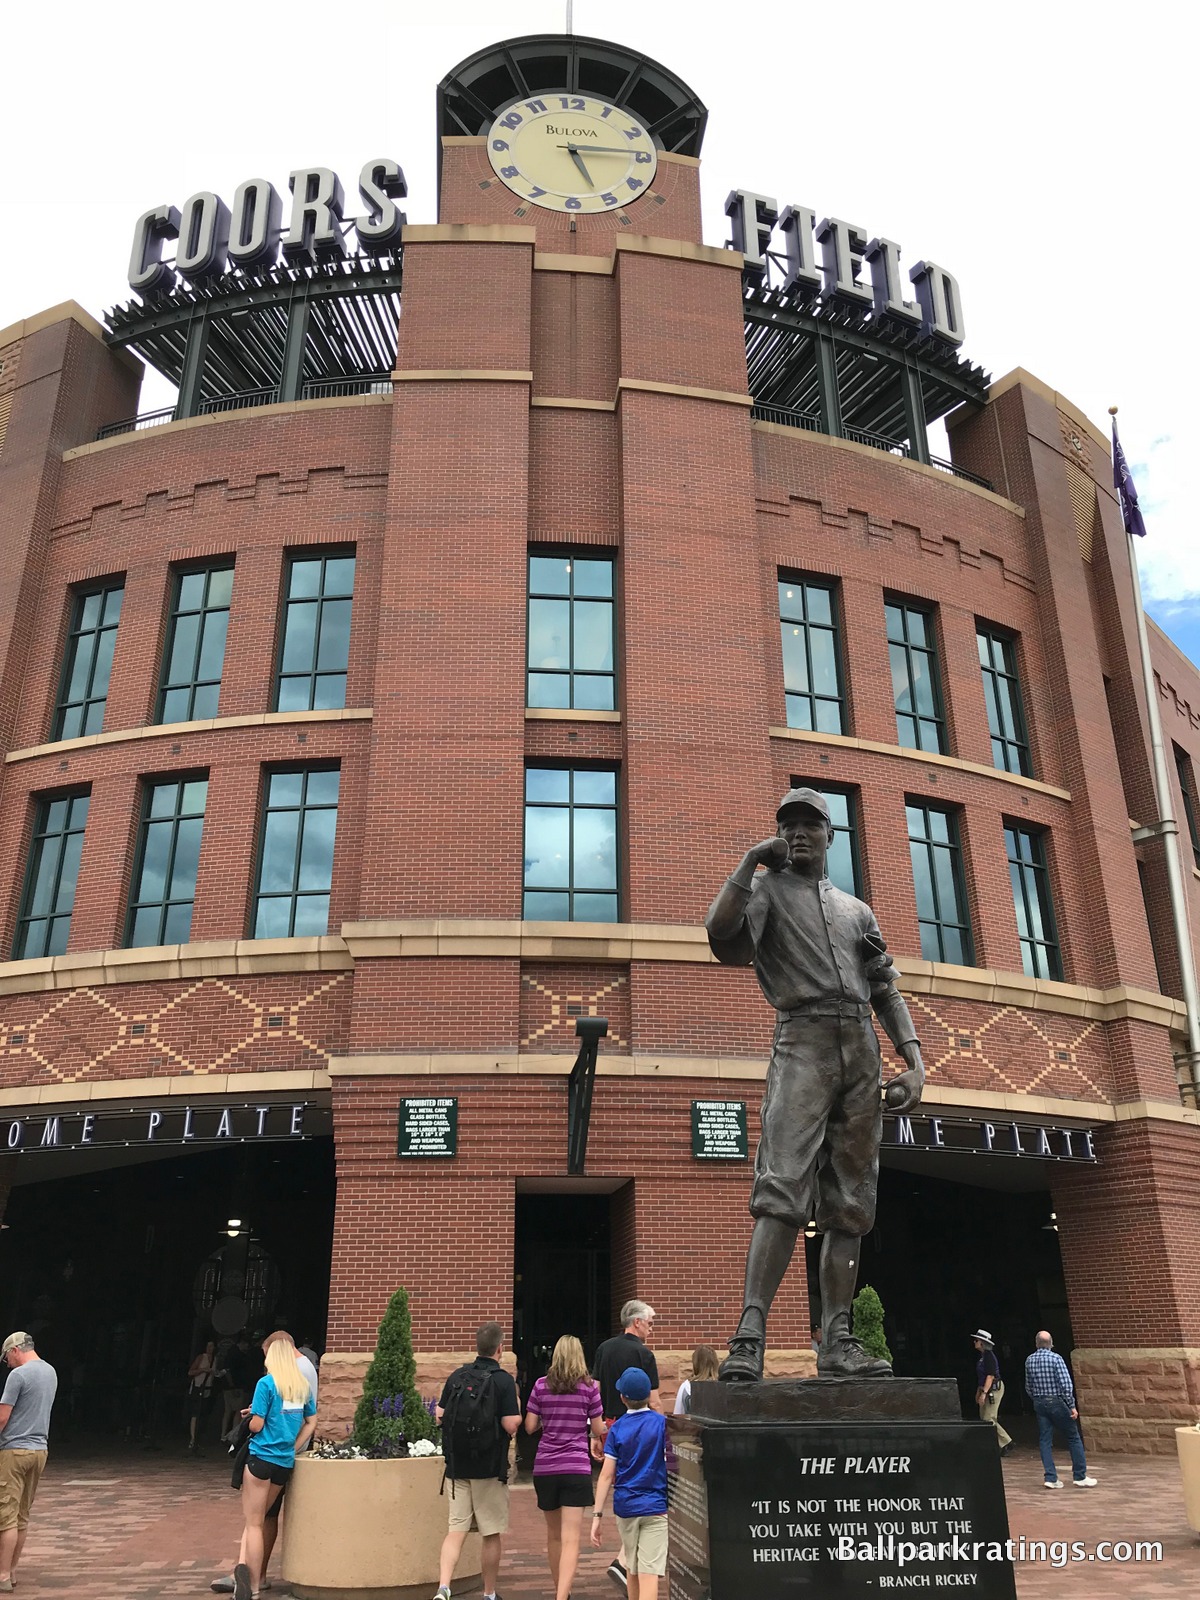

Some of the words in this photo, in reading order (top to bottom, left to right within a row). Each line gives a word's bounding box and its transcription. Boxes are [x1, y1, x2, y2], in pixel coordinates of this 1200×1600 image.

[525, 99, 548, 114] 11
[558, 97, 586, 111] 12
[600, 106, 613, 119] 1
[499, 112, 523, 131] 10
[622, 126, 642, 140] 2
[492, 139, 509, 152] 9
[635, 150, 652, 164] 3
[500, 165, 520, 179] 8
[626, 176, 644, 191] 4
[527, 185, 548, 199] 7
[600, 192, 618, 207] 5
[564, 196, 582, 210] 6
[127, 158, 407, 291] COORS
[725, 189, 966, 345] FIELD
[405, 1099, 436, 1107] PROHIBITED
[437, 1099, 453, 1107] ITEMS
[696, 1102, 725, 1110] PROHIBITED
[148, 1105, 304, 1141] PLATE
[983, 1122, 1097, 1159] PLATE
[800, 1457, 836, 1475] THE
[844, 1456, 911, 1474] PLAYER
[778, 1500, 790, 1514] IS
[797, 1499, 827, 1513] NOT
[834, 1499, 861, 1513] THE
[868, 1497, 922, 1512] HONOR
[929, 1497, 965, 1511] THAT
[749, 1524, 780, 1538] YOU
[786, 1523, 822, 1537] TAKE
[828, 1522, 868, 1537] WITH
[874, 1522, 905, 1535] YOU
[911, 1521, 938, 1535] BUT
[945, 1520, 972, 1534] THE
[753, 1547, 820, 1562] HERITAGE
[879, 1574, 930, 1588] BRANCH
[935, 1573, 978, 1587] RICKEY
